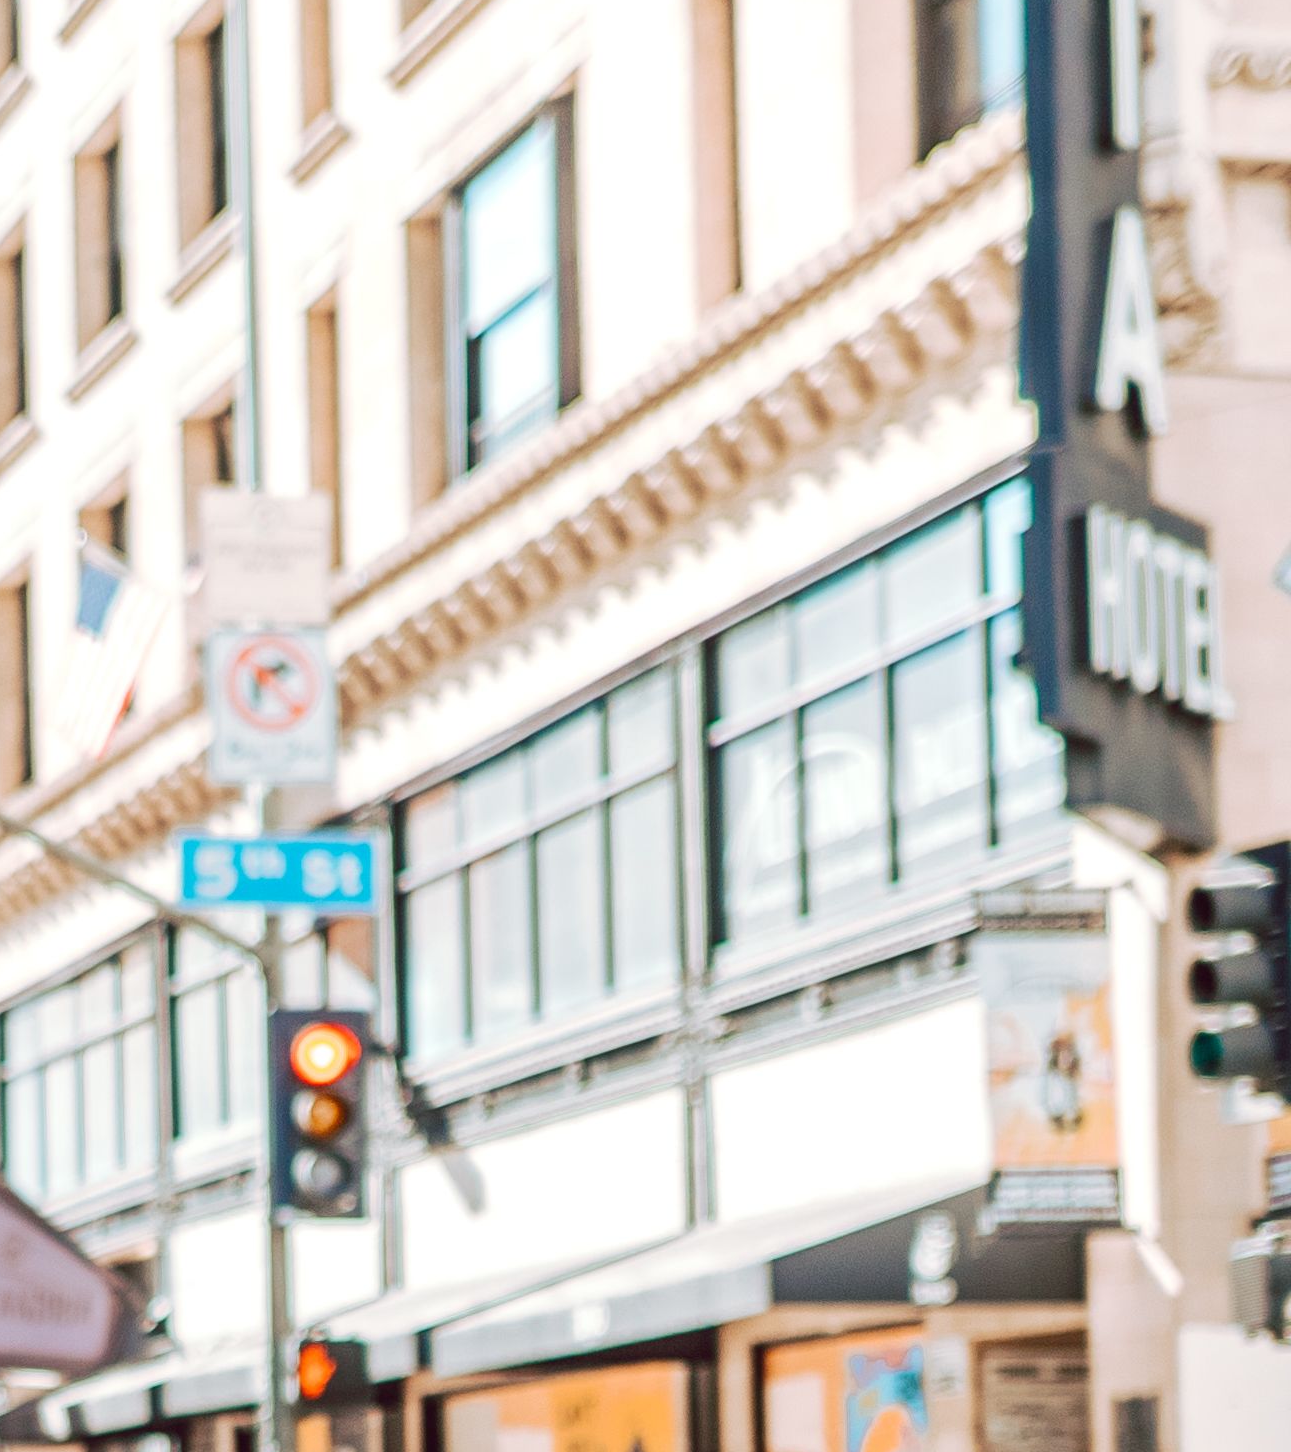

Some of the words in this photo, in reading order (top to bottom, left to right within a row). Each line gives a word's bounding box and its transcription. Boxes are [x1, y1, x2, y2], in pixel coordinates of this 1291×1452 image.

[1088, 501, 1236, 720] HOTEL
[193, 843, 287, 899] 5th
[301, 849, 364, 898] St
